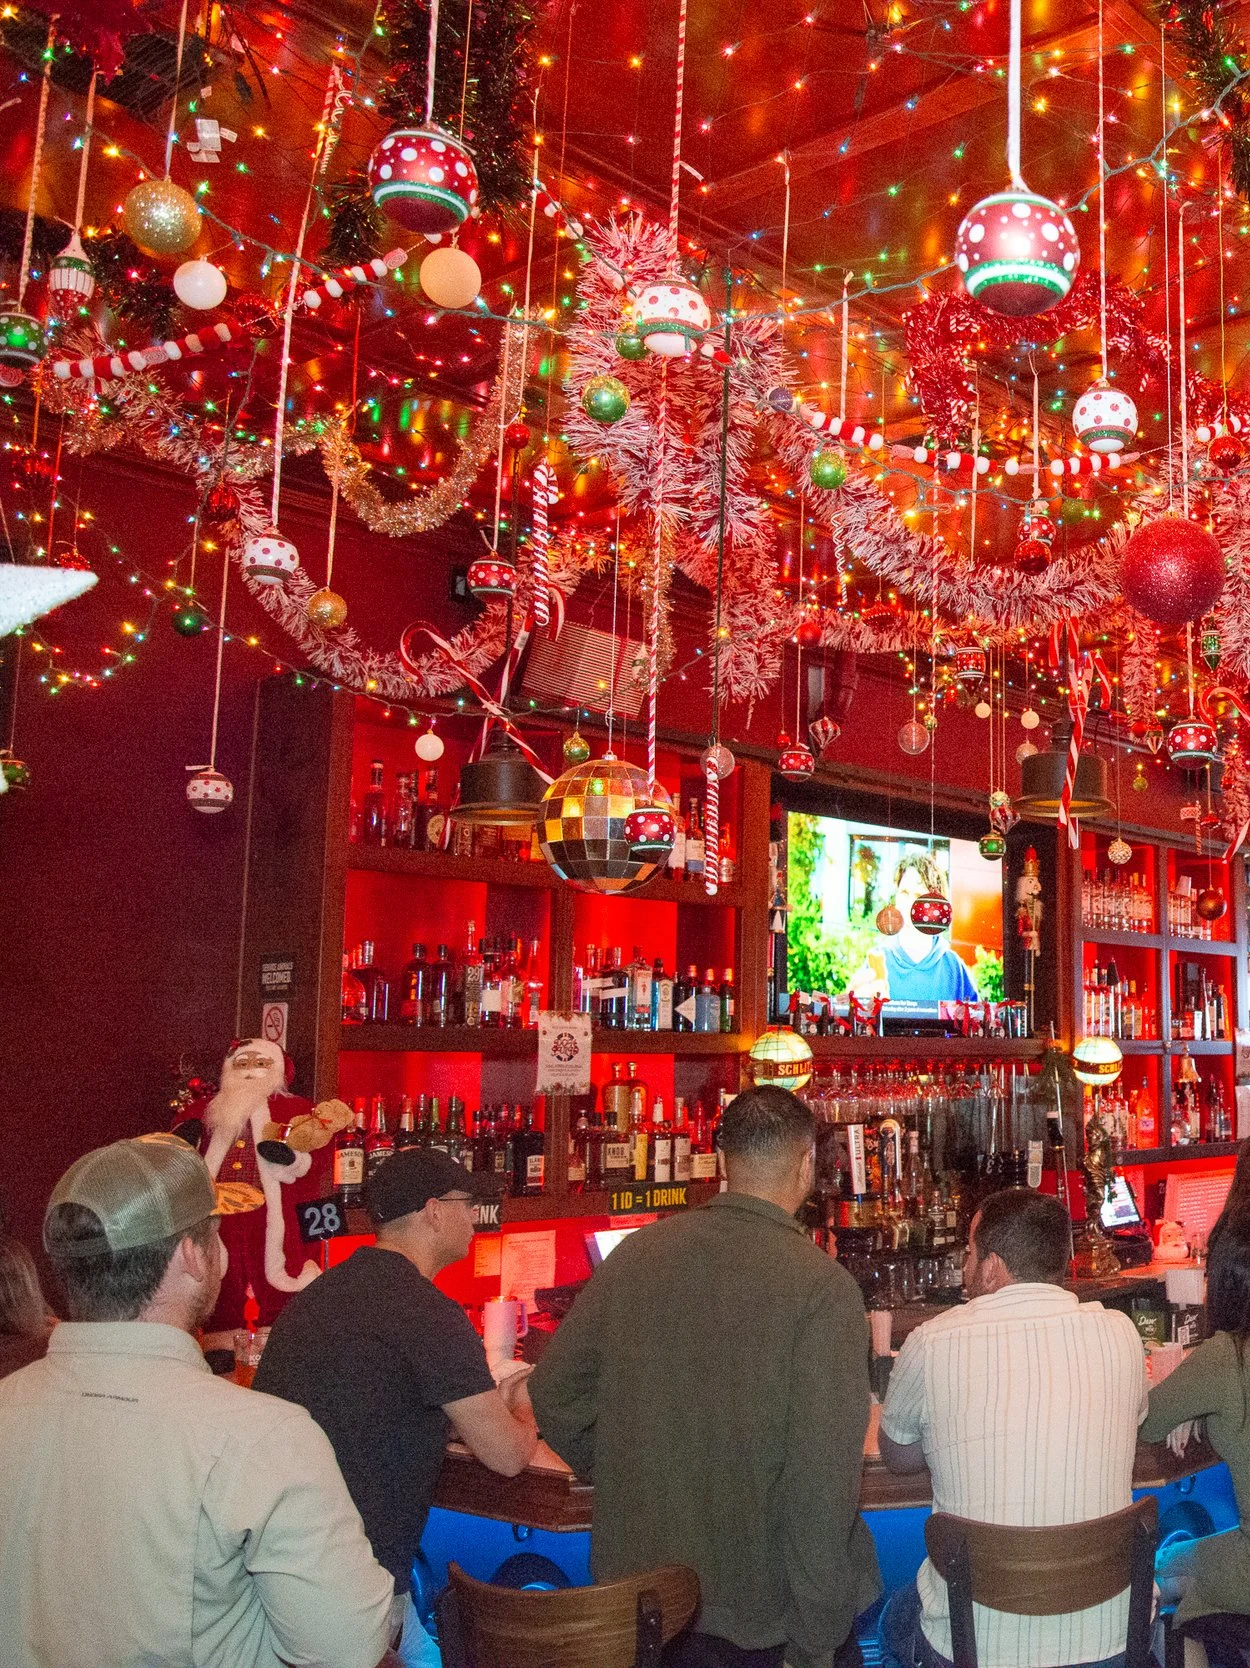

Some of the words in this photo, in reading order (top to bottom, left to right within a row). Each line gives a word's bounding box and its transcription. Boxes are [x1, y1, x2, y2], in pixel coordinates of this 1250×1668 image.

[612, 1192, 617, 1210] 1
[620, 1191, 633, 1209] ID
[645, 1190, 651, 1207] 1
[653, 1187, 687, 1206] DRINK
[305, 1203, 340, 1235] 28
